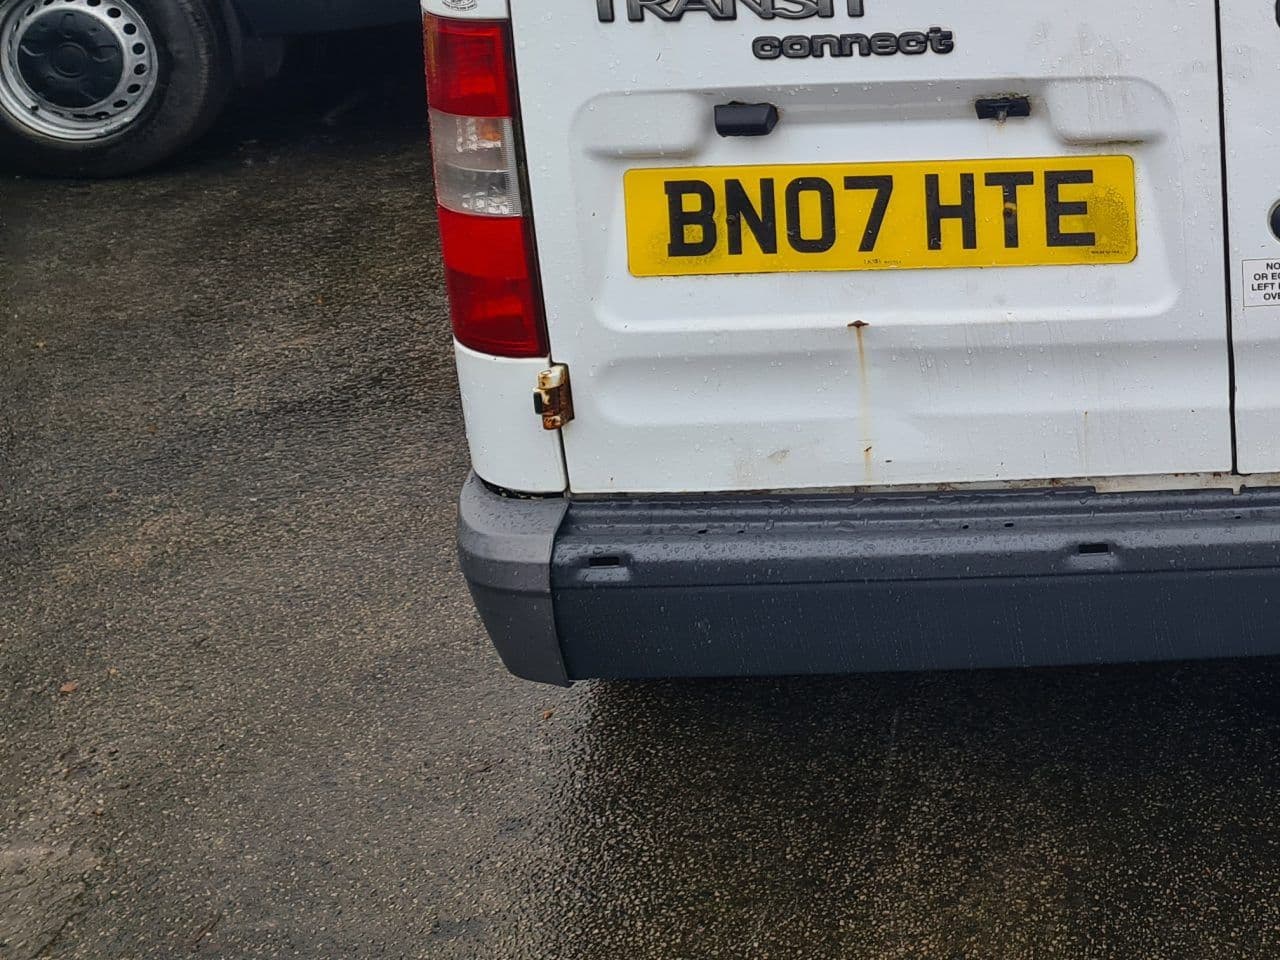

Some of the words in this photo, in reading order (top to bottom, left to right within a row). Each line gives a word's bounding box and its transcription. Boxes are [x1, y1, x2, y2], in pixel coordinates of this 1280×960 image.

[752, 26, 955, 60] connect
[664, 174, 894, 258] BN07
[925, 169, 1096, 251] HTE
[1266, 262, 1280, 270] NO
[1253, 273, 1268, 281] OR
[1251, 283, 1275, 291] LEFT
